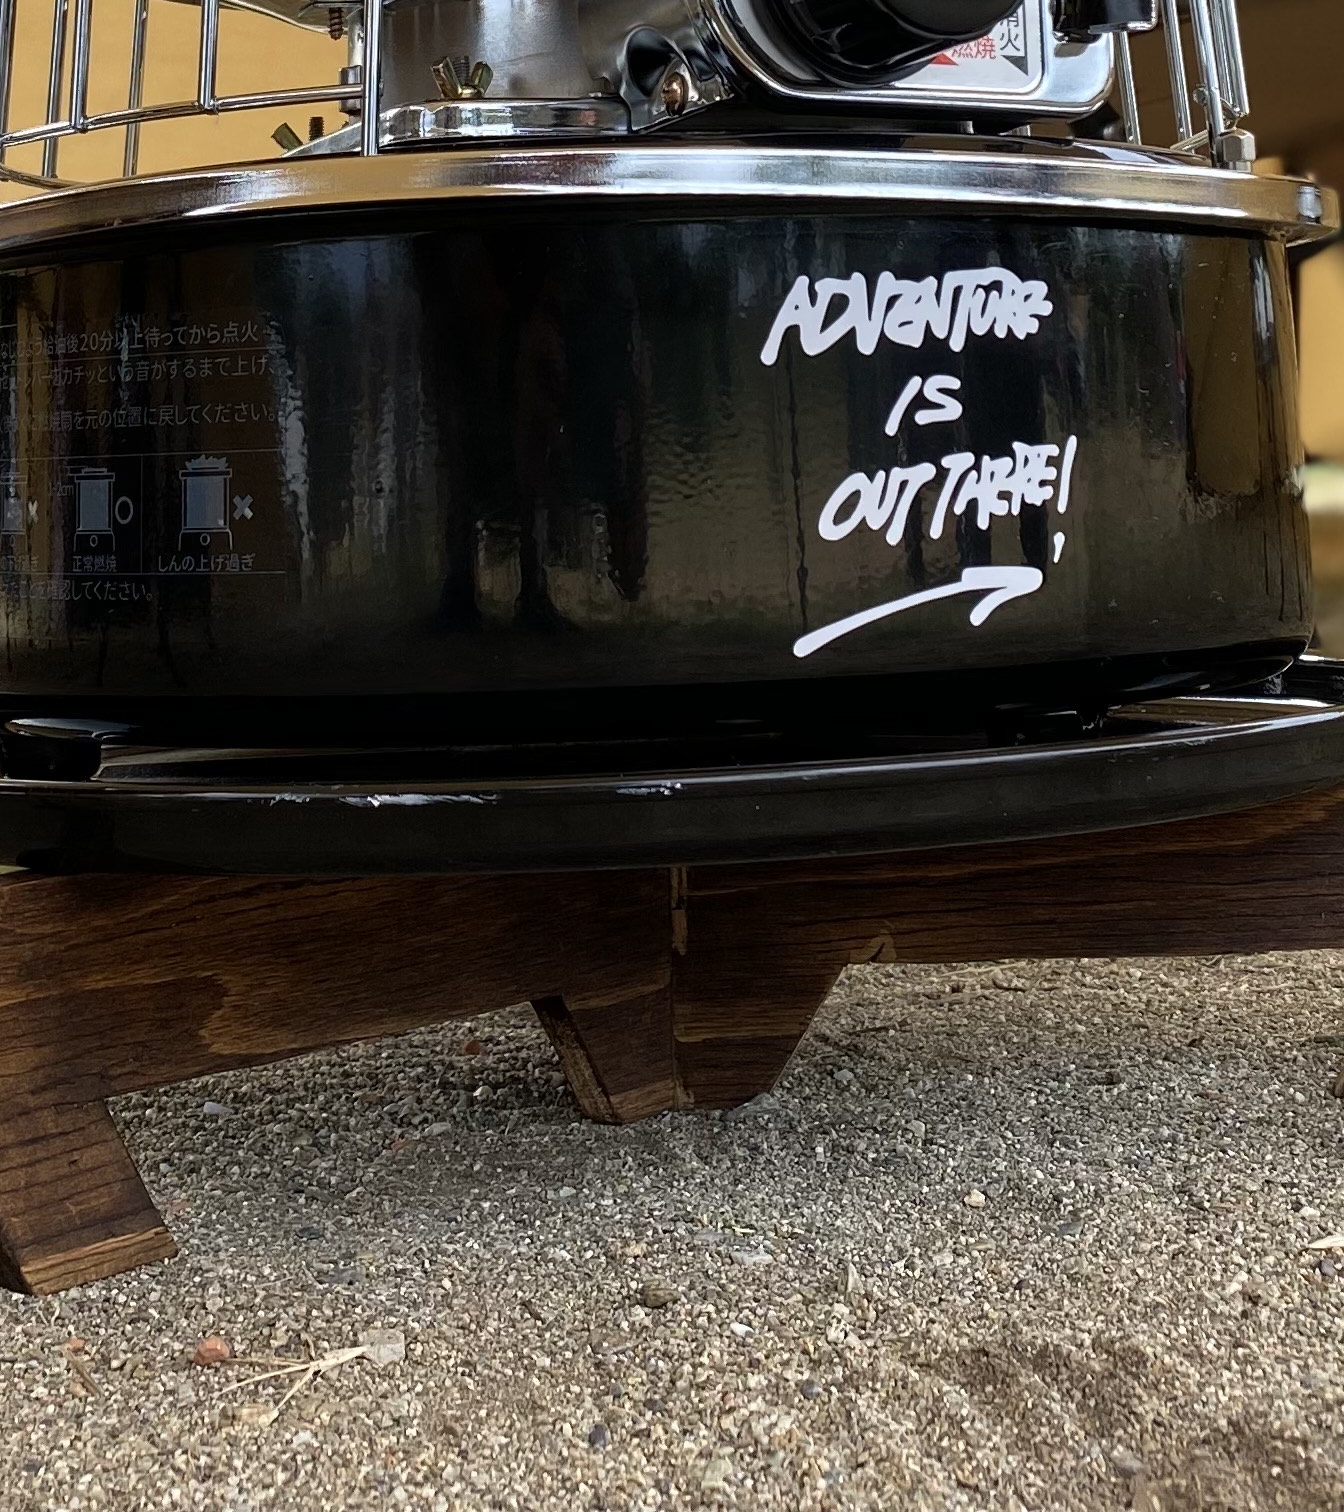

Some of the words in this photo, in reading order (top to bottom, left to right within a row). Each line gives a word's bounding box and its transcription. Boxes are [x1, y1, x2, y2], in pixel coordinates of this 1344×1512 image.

[760, 266, 1053, 366] ADVENTURE
[885, 374, 963, 437] IS
[818, 462, 937, 547] OUT
[929, 435, 1078, 563] THERE!
[157, 553, 256, 572] しんの上げ過ぎ
